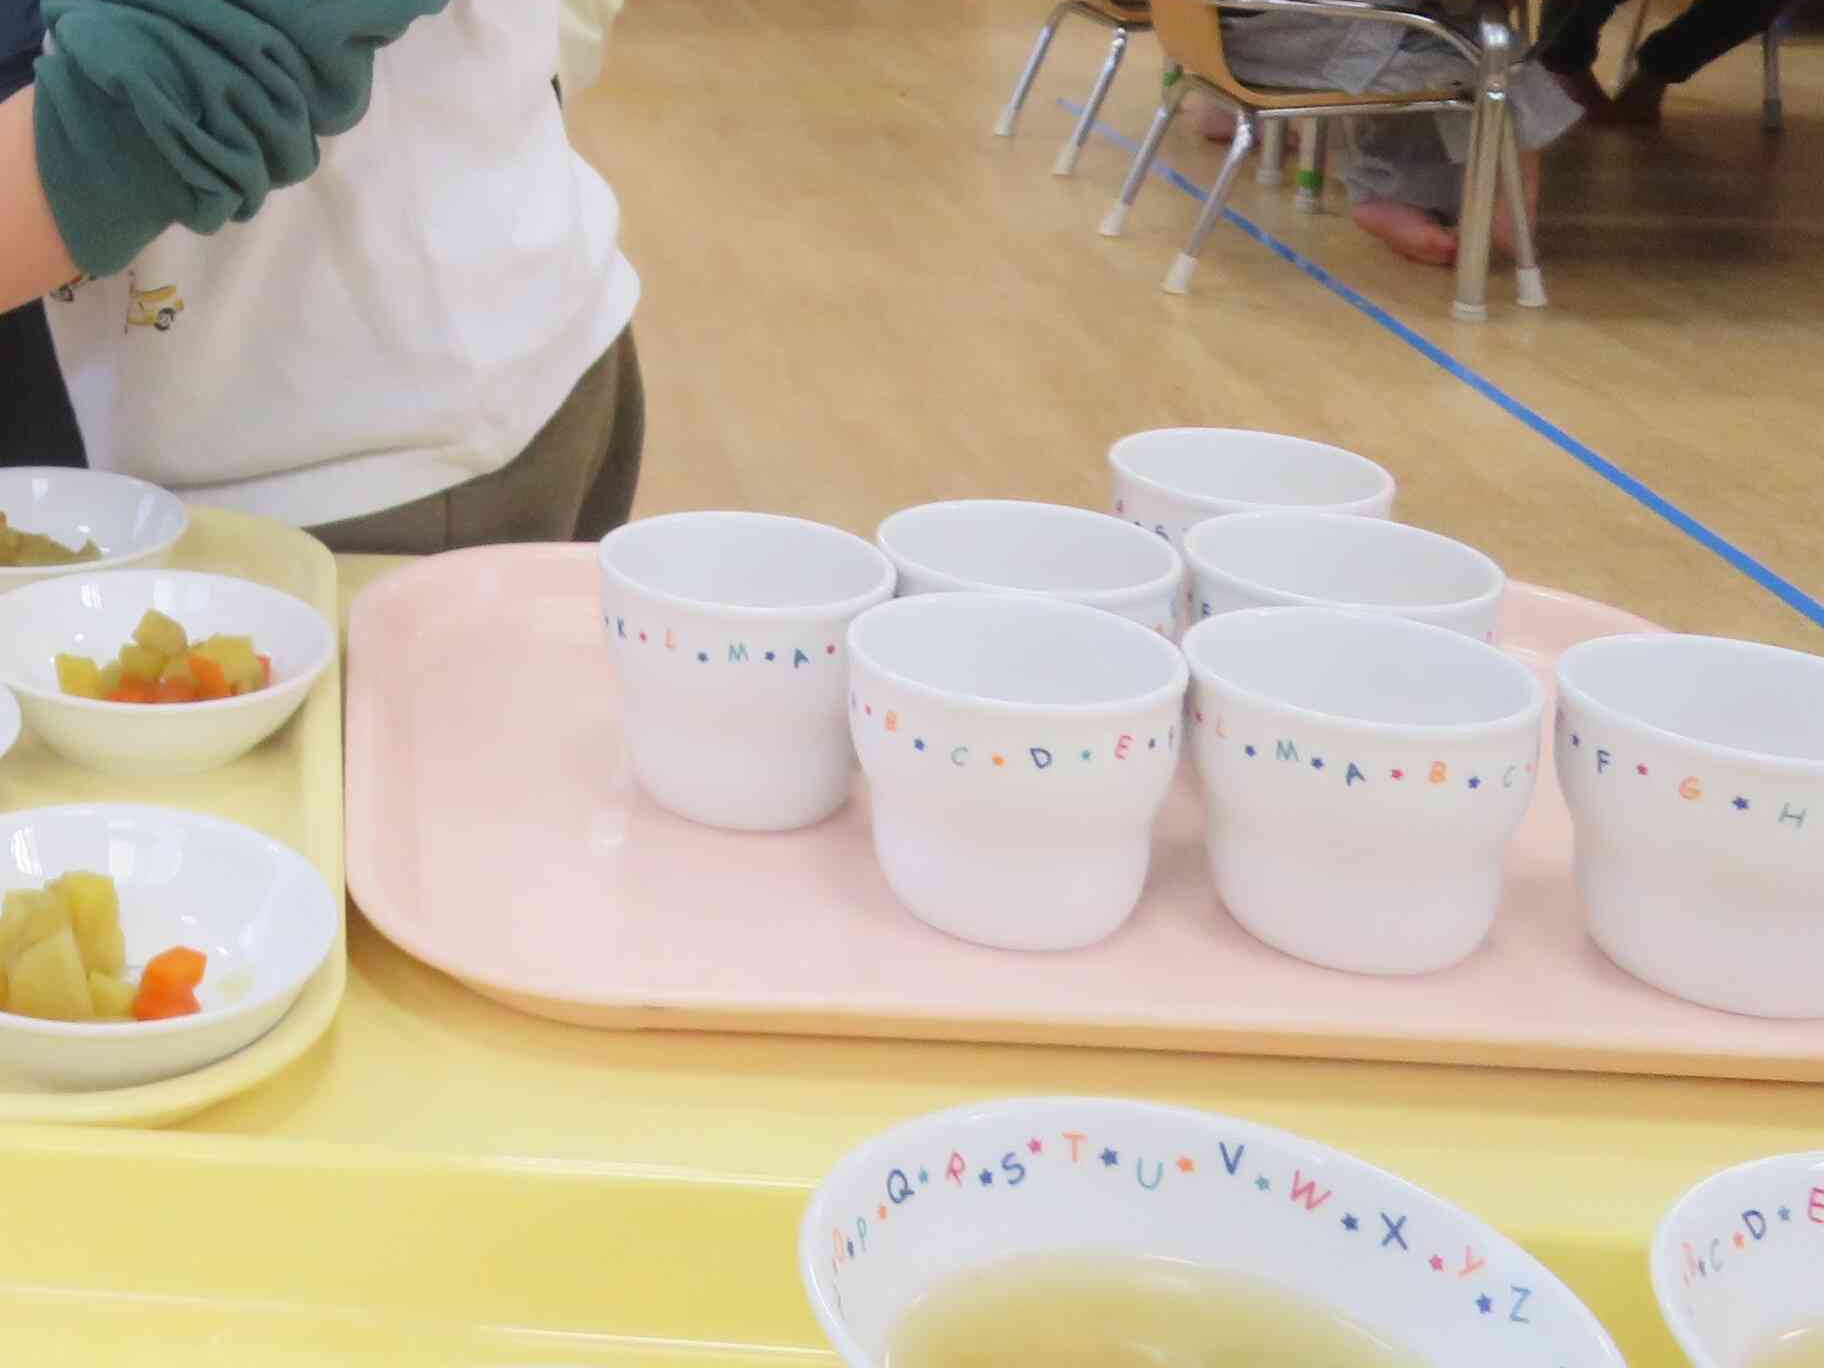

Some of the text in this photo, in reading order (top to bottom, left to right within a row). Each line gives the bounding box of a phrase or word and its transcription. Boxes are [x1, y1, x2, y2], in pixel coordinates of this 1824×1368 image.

[1029, 748, 1052, 769] D
[1276, 738, 1300, 763] M
[1345, 761, 1366, 787] A
[1428, 760, 1448, 785] B
[1596, 749, 1808, 829] F G H
[886, 1168, 915, 1204] Q
[945, 1150, 966, 1187] R
[1001, 1151, 1025, 1185] S
[1062, 1131, 1089, 1163] T
[1136, 1157, 1164, 1190] U
[1219, 1140, 1245, 1176] V
[1289, 1169, 1332, 1211] W
[1380, 1211, 1409, 1252] X
[1456, 1244, 1487, 1278] Y
[1508, 1284, 1533, 1324] Z
[1741, 1209, 1767, 1241] D
